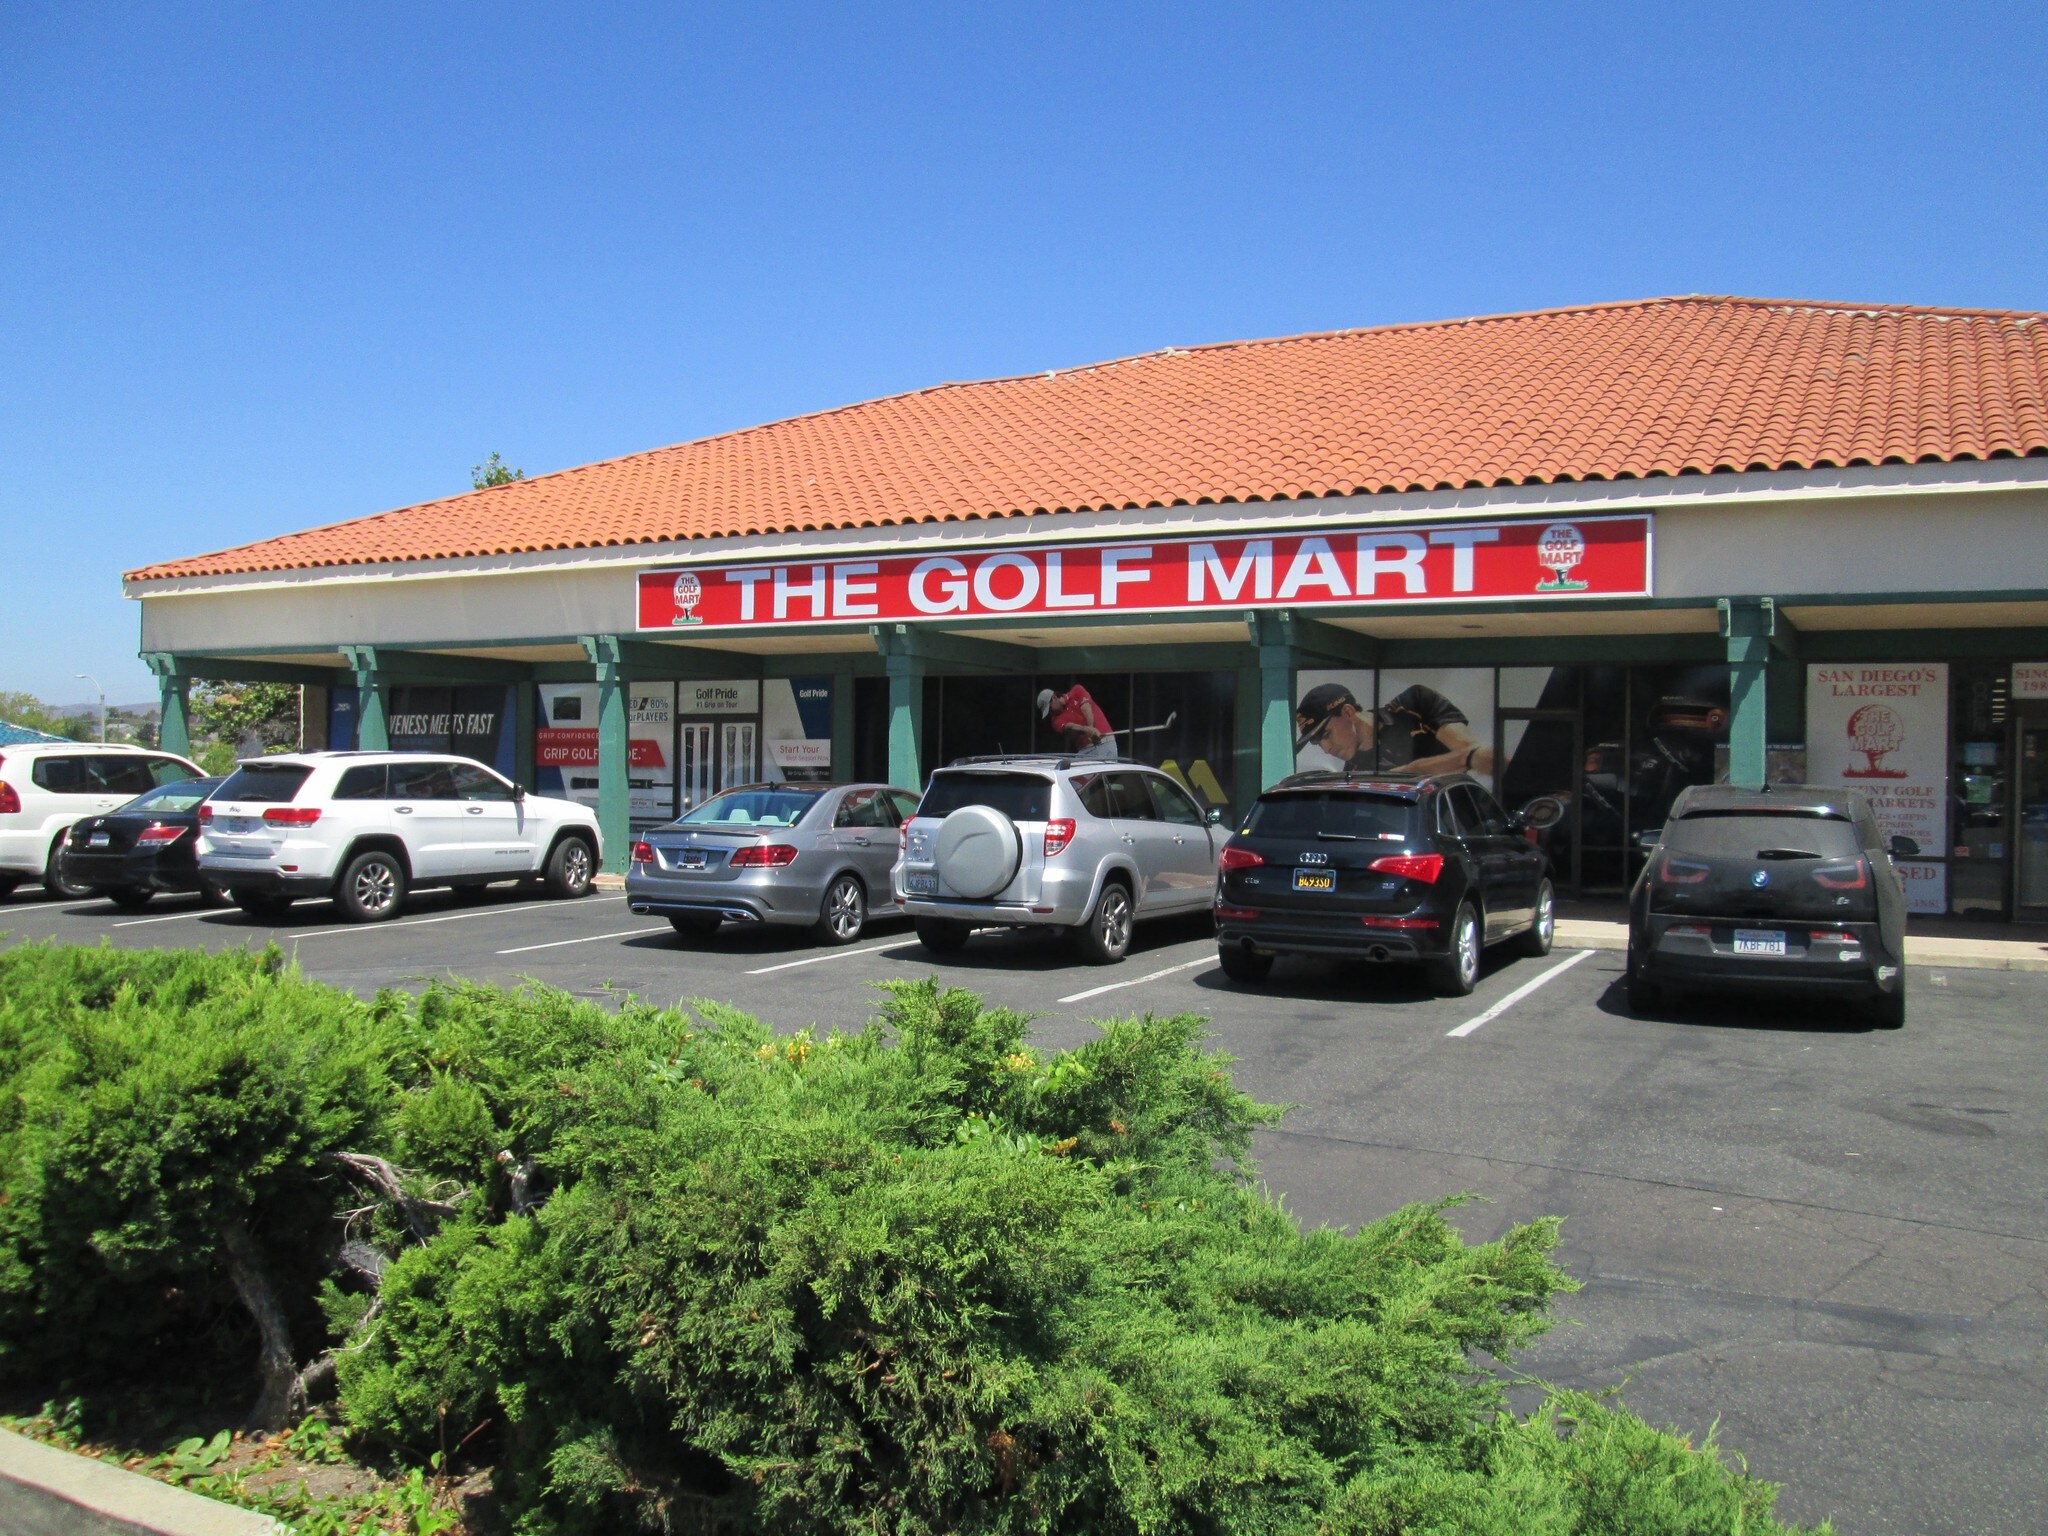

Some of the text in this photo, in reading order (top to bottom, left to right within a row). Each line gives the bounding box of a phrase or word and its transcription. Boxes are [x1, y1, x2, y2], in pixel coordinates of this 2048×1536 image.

[1551, 529, 1573, 538] THE
[1545, 540, 1578, 551] GOLF
[1541, 552, 1581, 564] MART
[725, 529, 1499, 620] THE GOLF MART
[678, 585, 698, 593] GOLF
[676, 595, 699, 604] MART
[1818, 668, 1936, 682] SAN DIEGO'S
[696, 688, 738, 700] Golf Pride
[800, 689, 828, 698] Golf Pride
[1832, 684, 1920, 697] LARGEST
[650, 699, 668, 709] 80%
[1863, 711, 1891, 723] THE
[390, 713, 494, 735] VENESS MEETS FAST
[1856, 723, 1895, 736] GOLF
[780, 745, 820, 753] Start Your
[1850, 737, 1902, 752] MART
[544, 748, 569, 760] GRIP
[572, 748, 598, 760] GOLF
[1894, 786, 1934, 796] GOLF
[1898, 867, 1936, 880] SED
